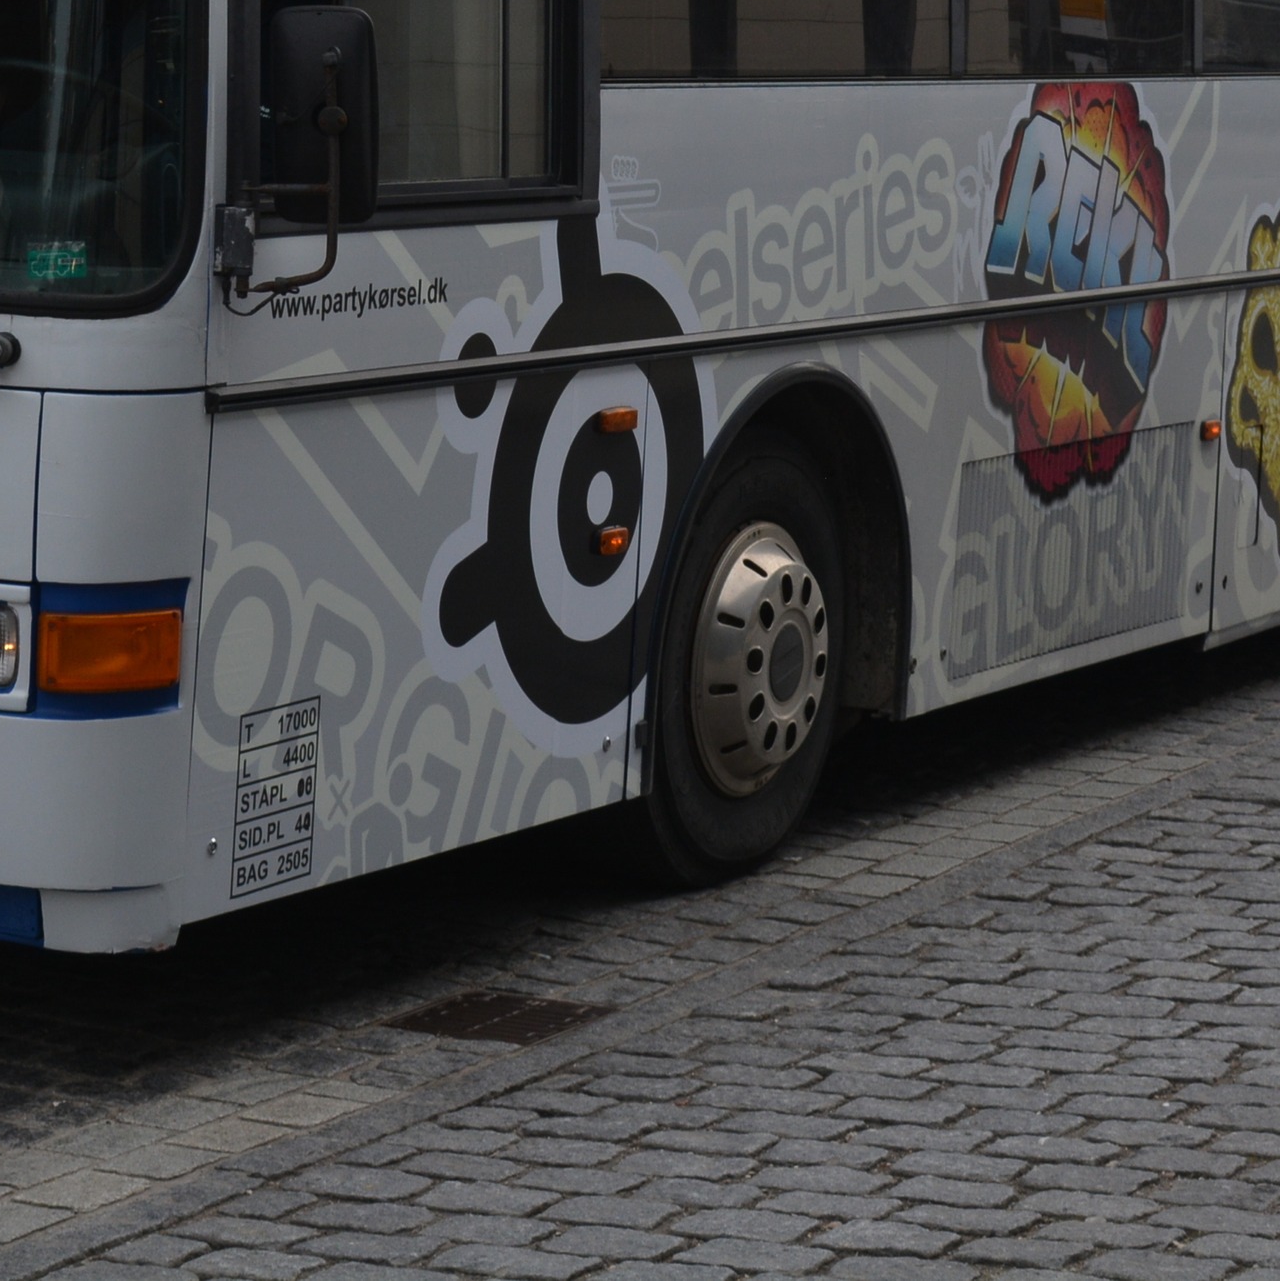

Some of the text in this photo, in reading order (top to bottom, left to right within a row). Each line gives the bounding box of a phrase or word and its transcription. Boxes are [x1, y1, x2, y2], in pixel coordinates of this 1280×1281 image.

[270, 276, 448, 321] www.partykørsel.dk
[245, 707, 317, 743] T 17000
[243, 741, 315, 779] L 4400
[240, 782, 287, 814] STÅPL
[238, 820, 285, 851] SID.PL
[236, 847, 309, 888] BAG 2505
